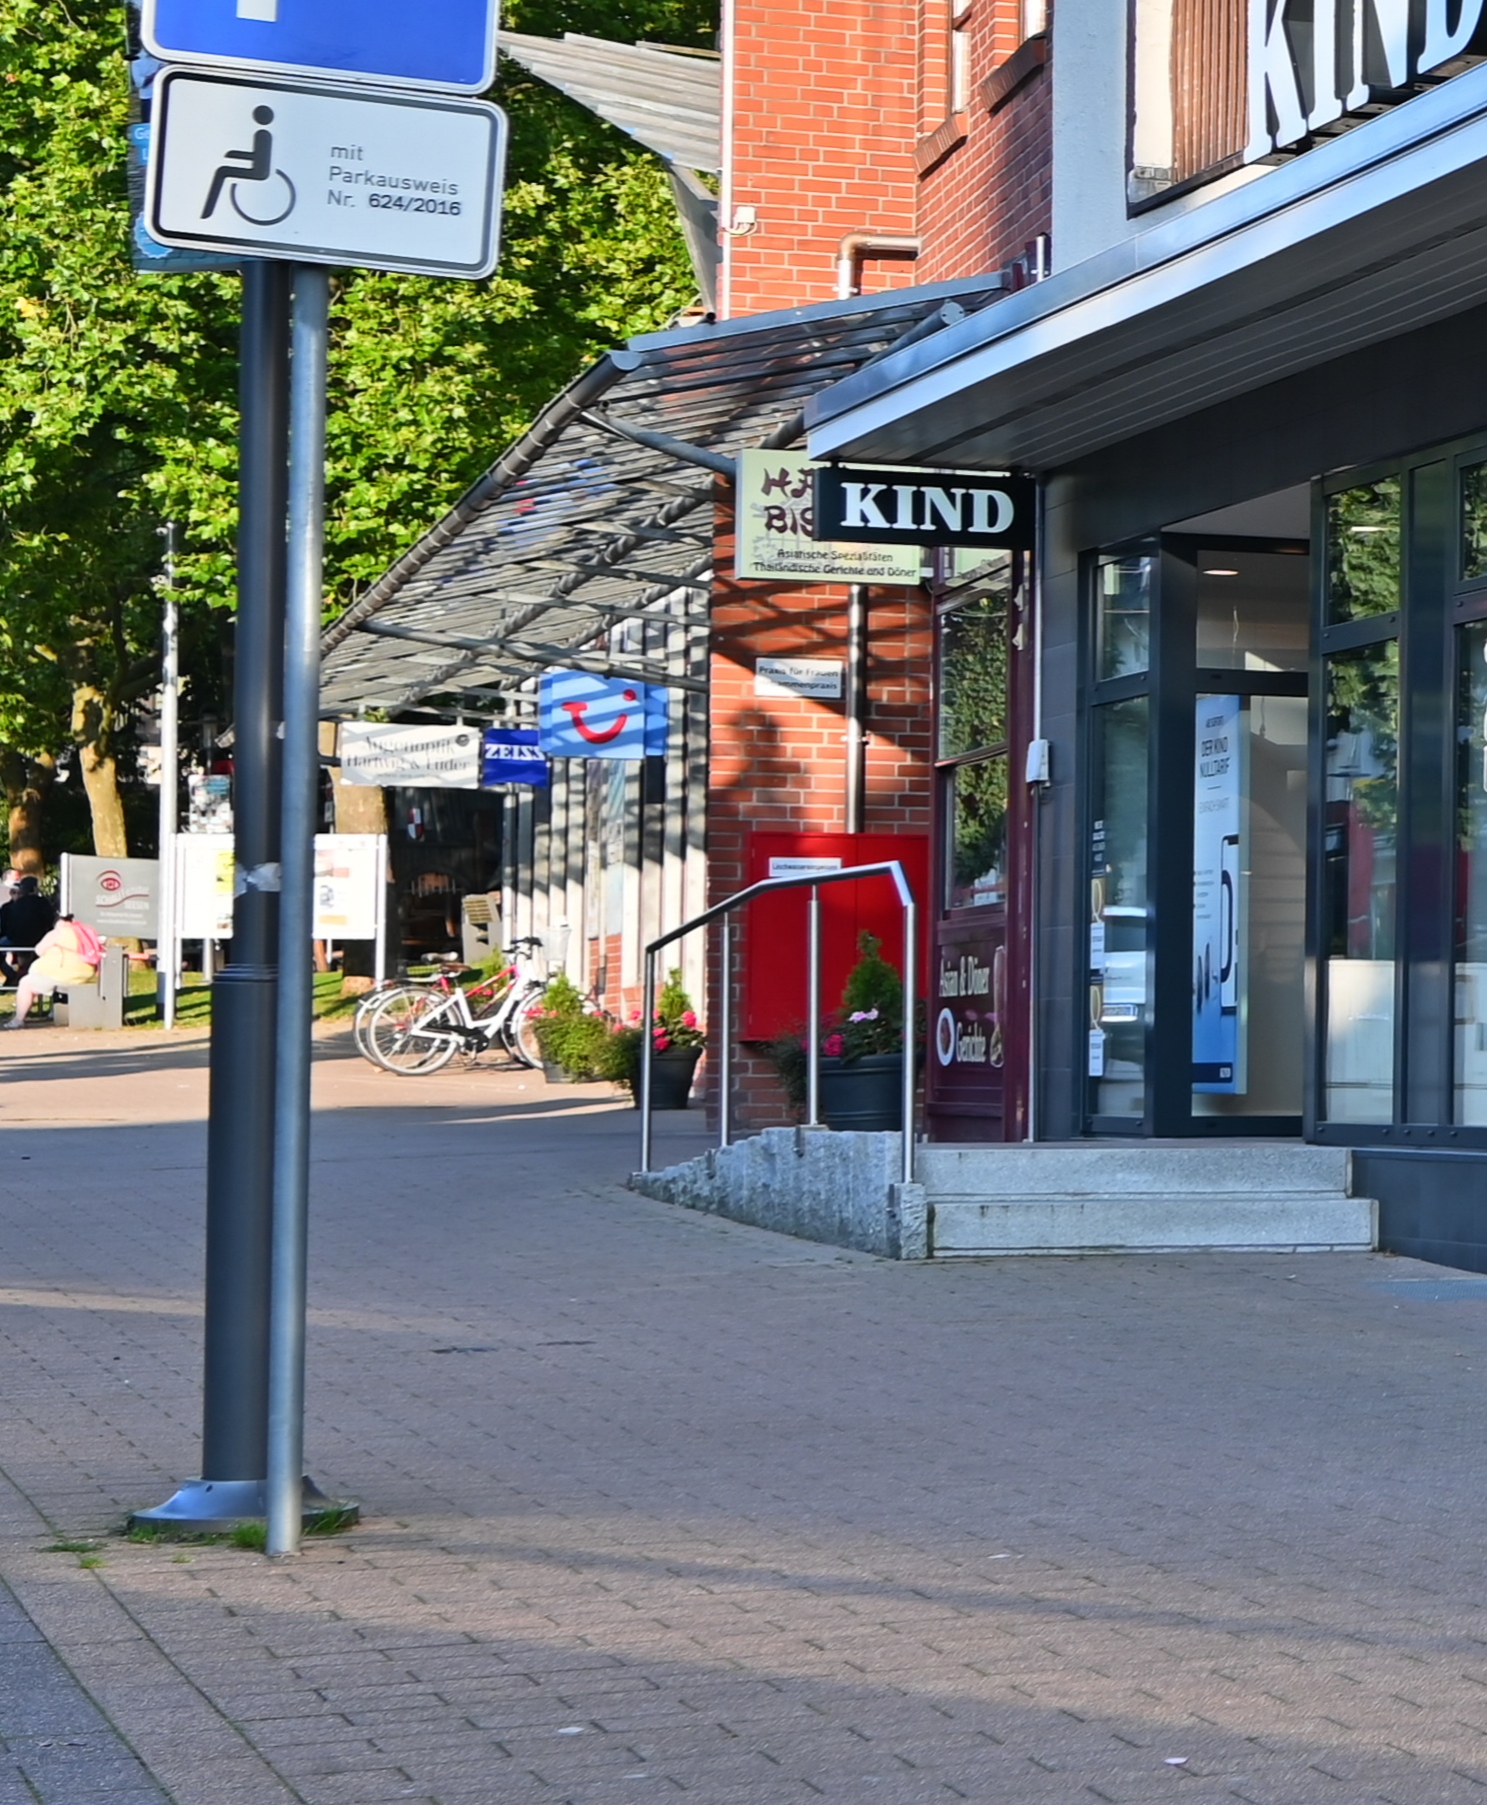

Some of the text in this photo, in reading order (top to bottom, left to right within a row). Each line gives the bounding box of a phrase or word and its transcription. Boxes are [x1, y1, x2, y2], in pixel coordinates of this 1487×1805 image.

[329, 143, 364, 162] mit
[328, 165, 460, 196] Parkausweis
[327, 188, 463, 216] Nr. 624/2016
[840, 482, 1015, 534] KIND
[484, 743, 547, 761] ZEISS
